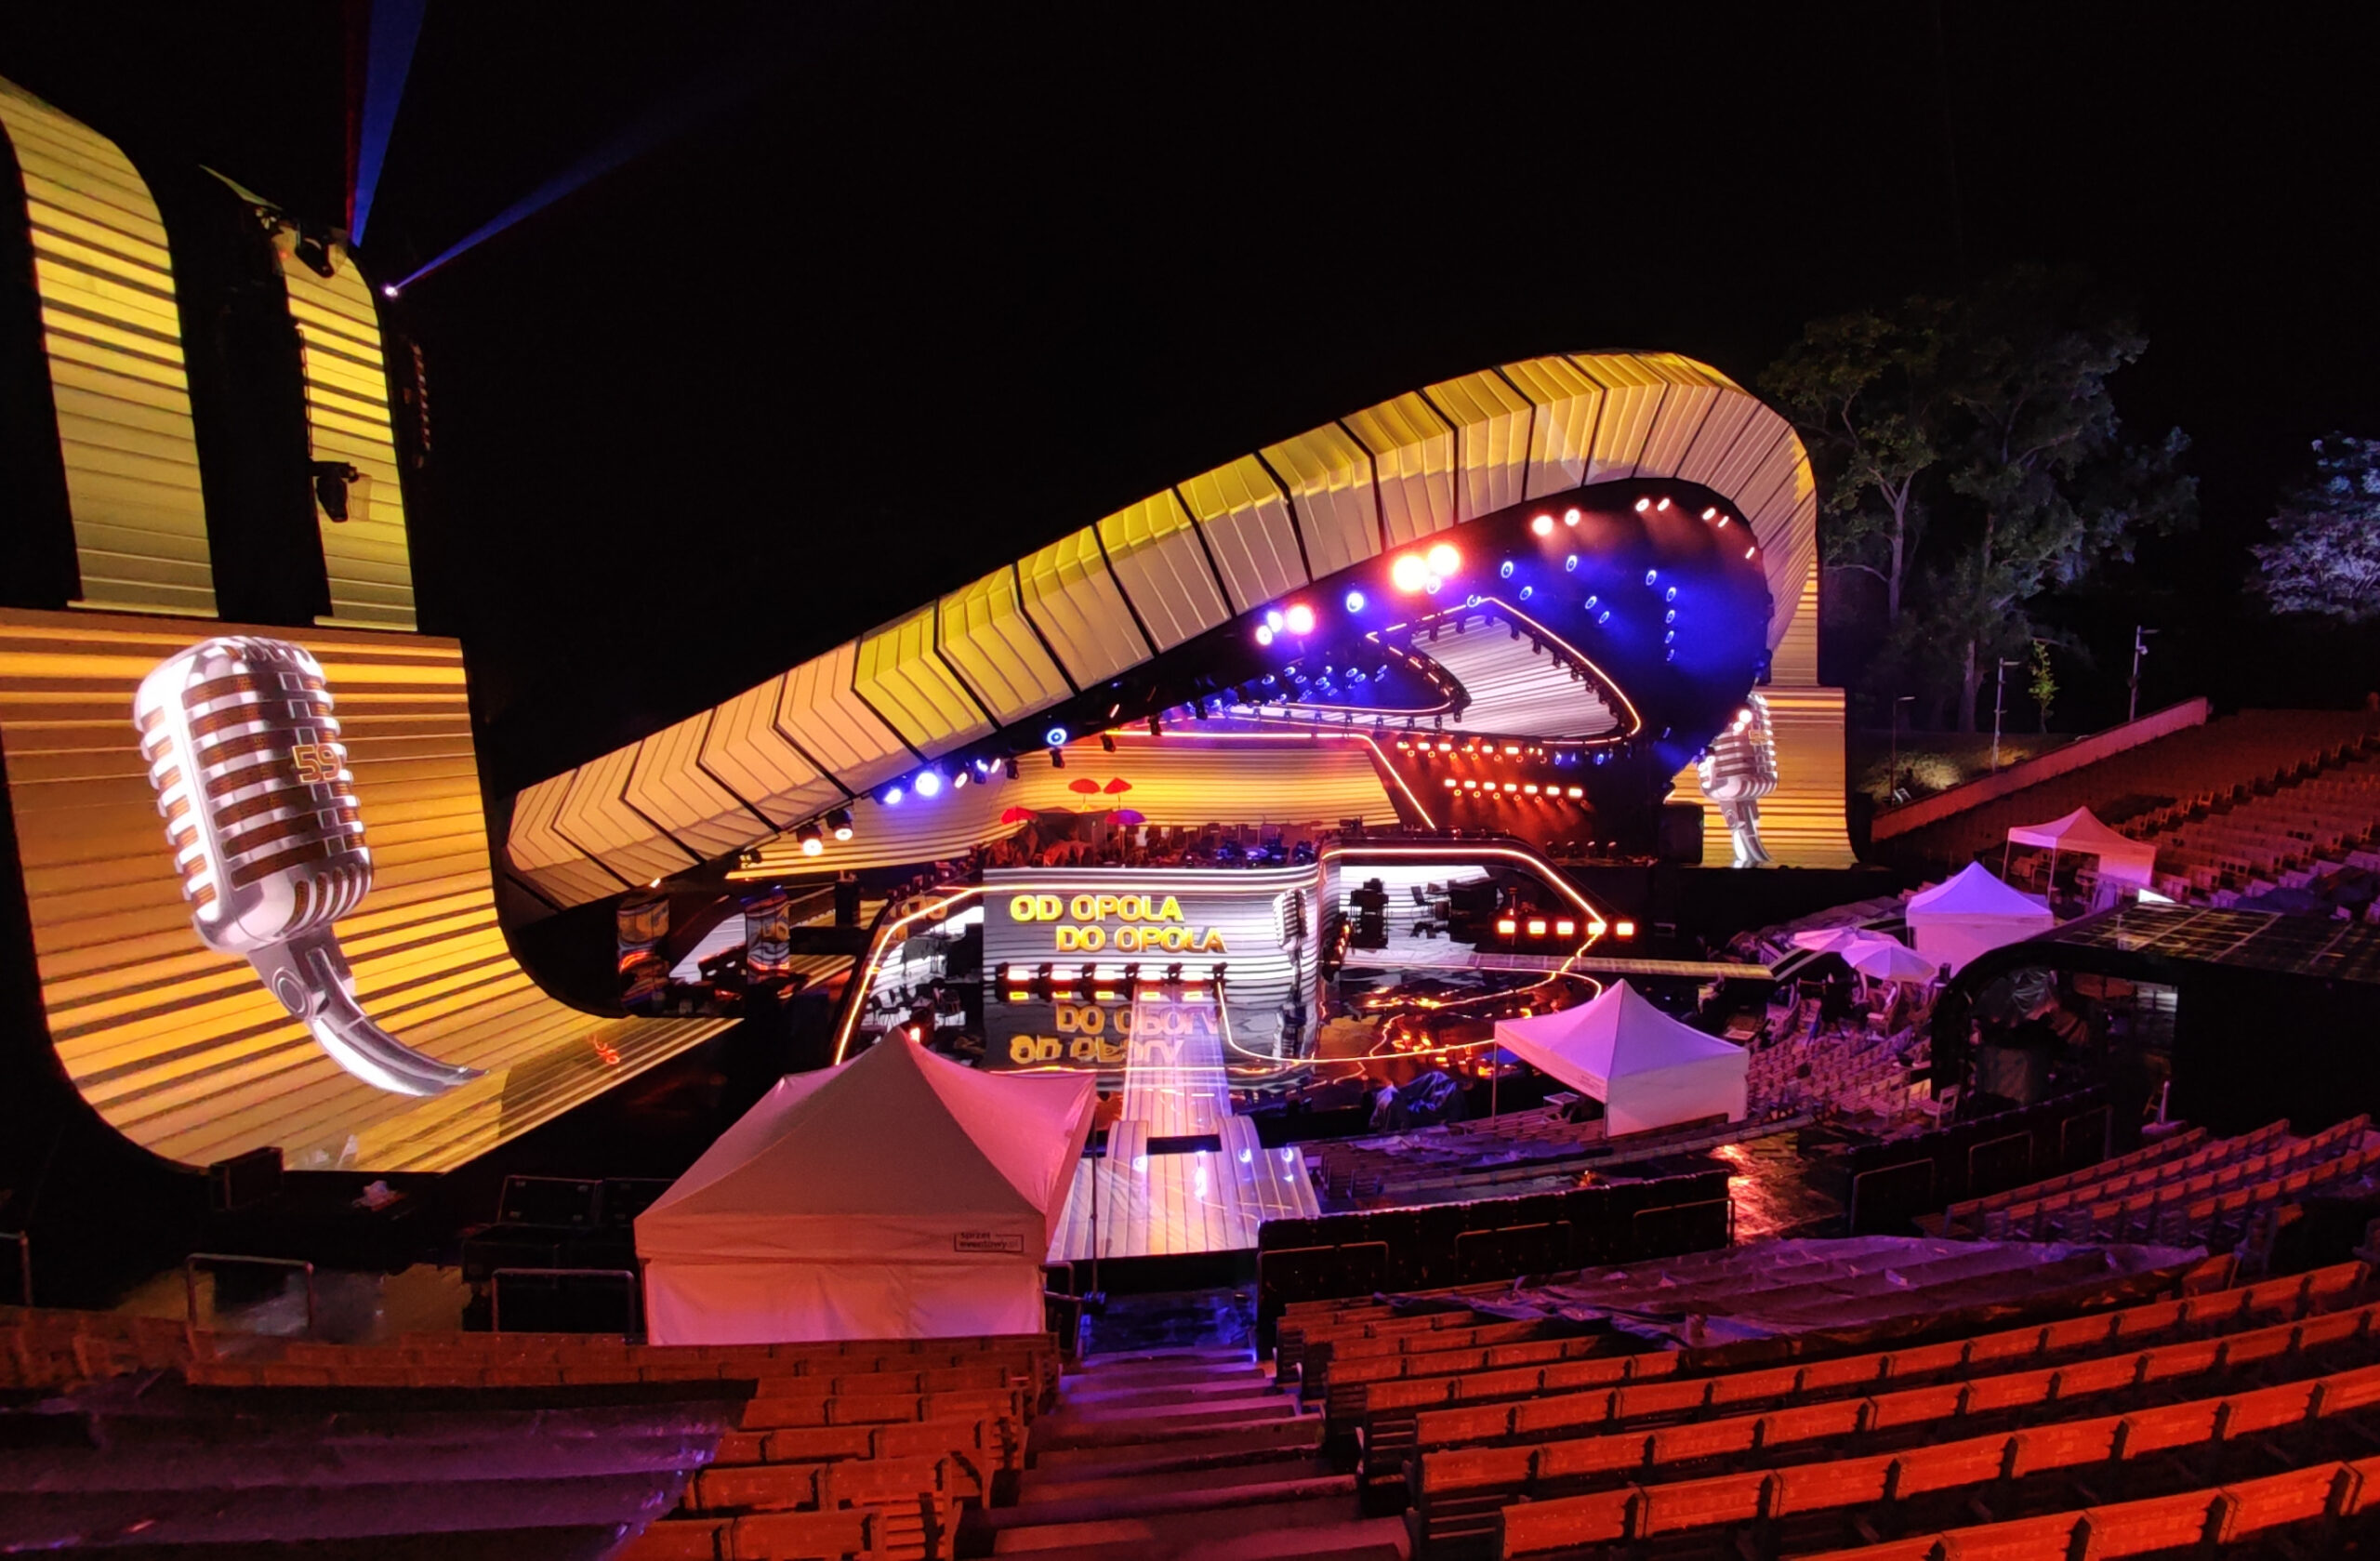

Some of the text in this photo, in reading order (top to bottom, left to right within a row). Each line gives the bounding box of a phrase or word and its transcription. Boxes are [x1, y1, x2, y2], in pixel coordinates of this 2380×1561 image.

[292, 743, 342, 783] 59
[1010, 894, 1185, 922] OD OPOLA
[1056, 925, 1228, 953] DO OPOLA
